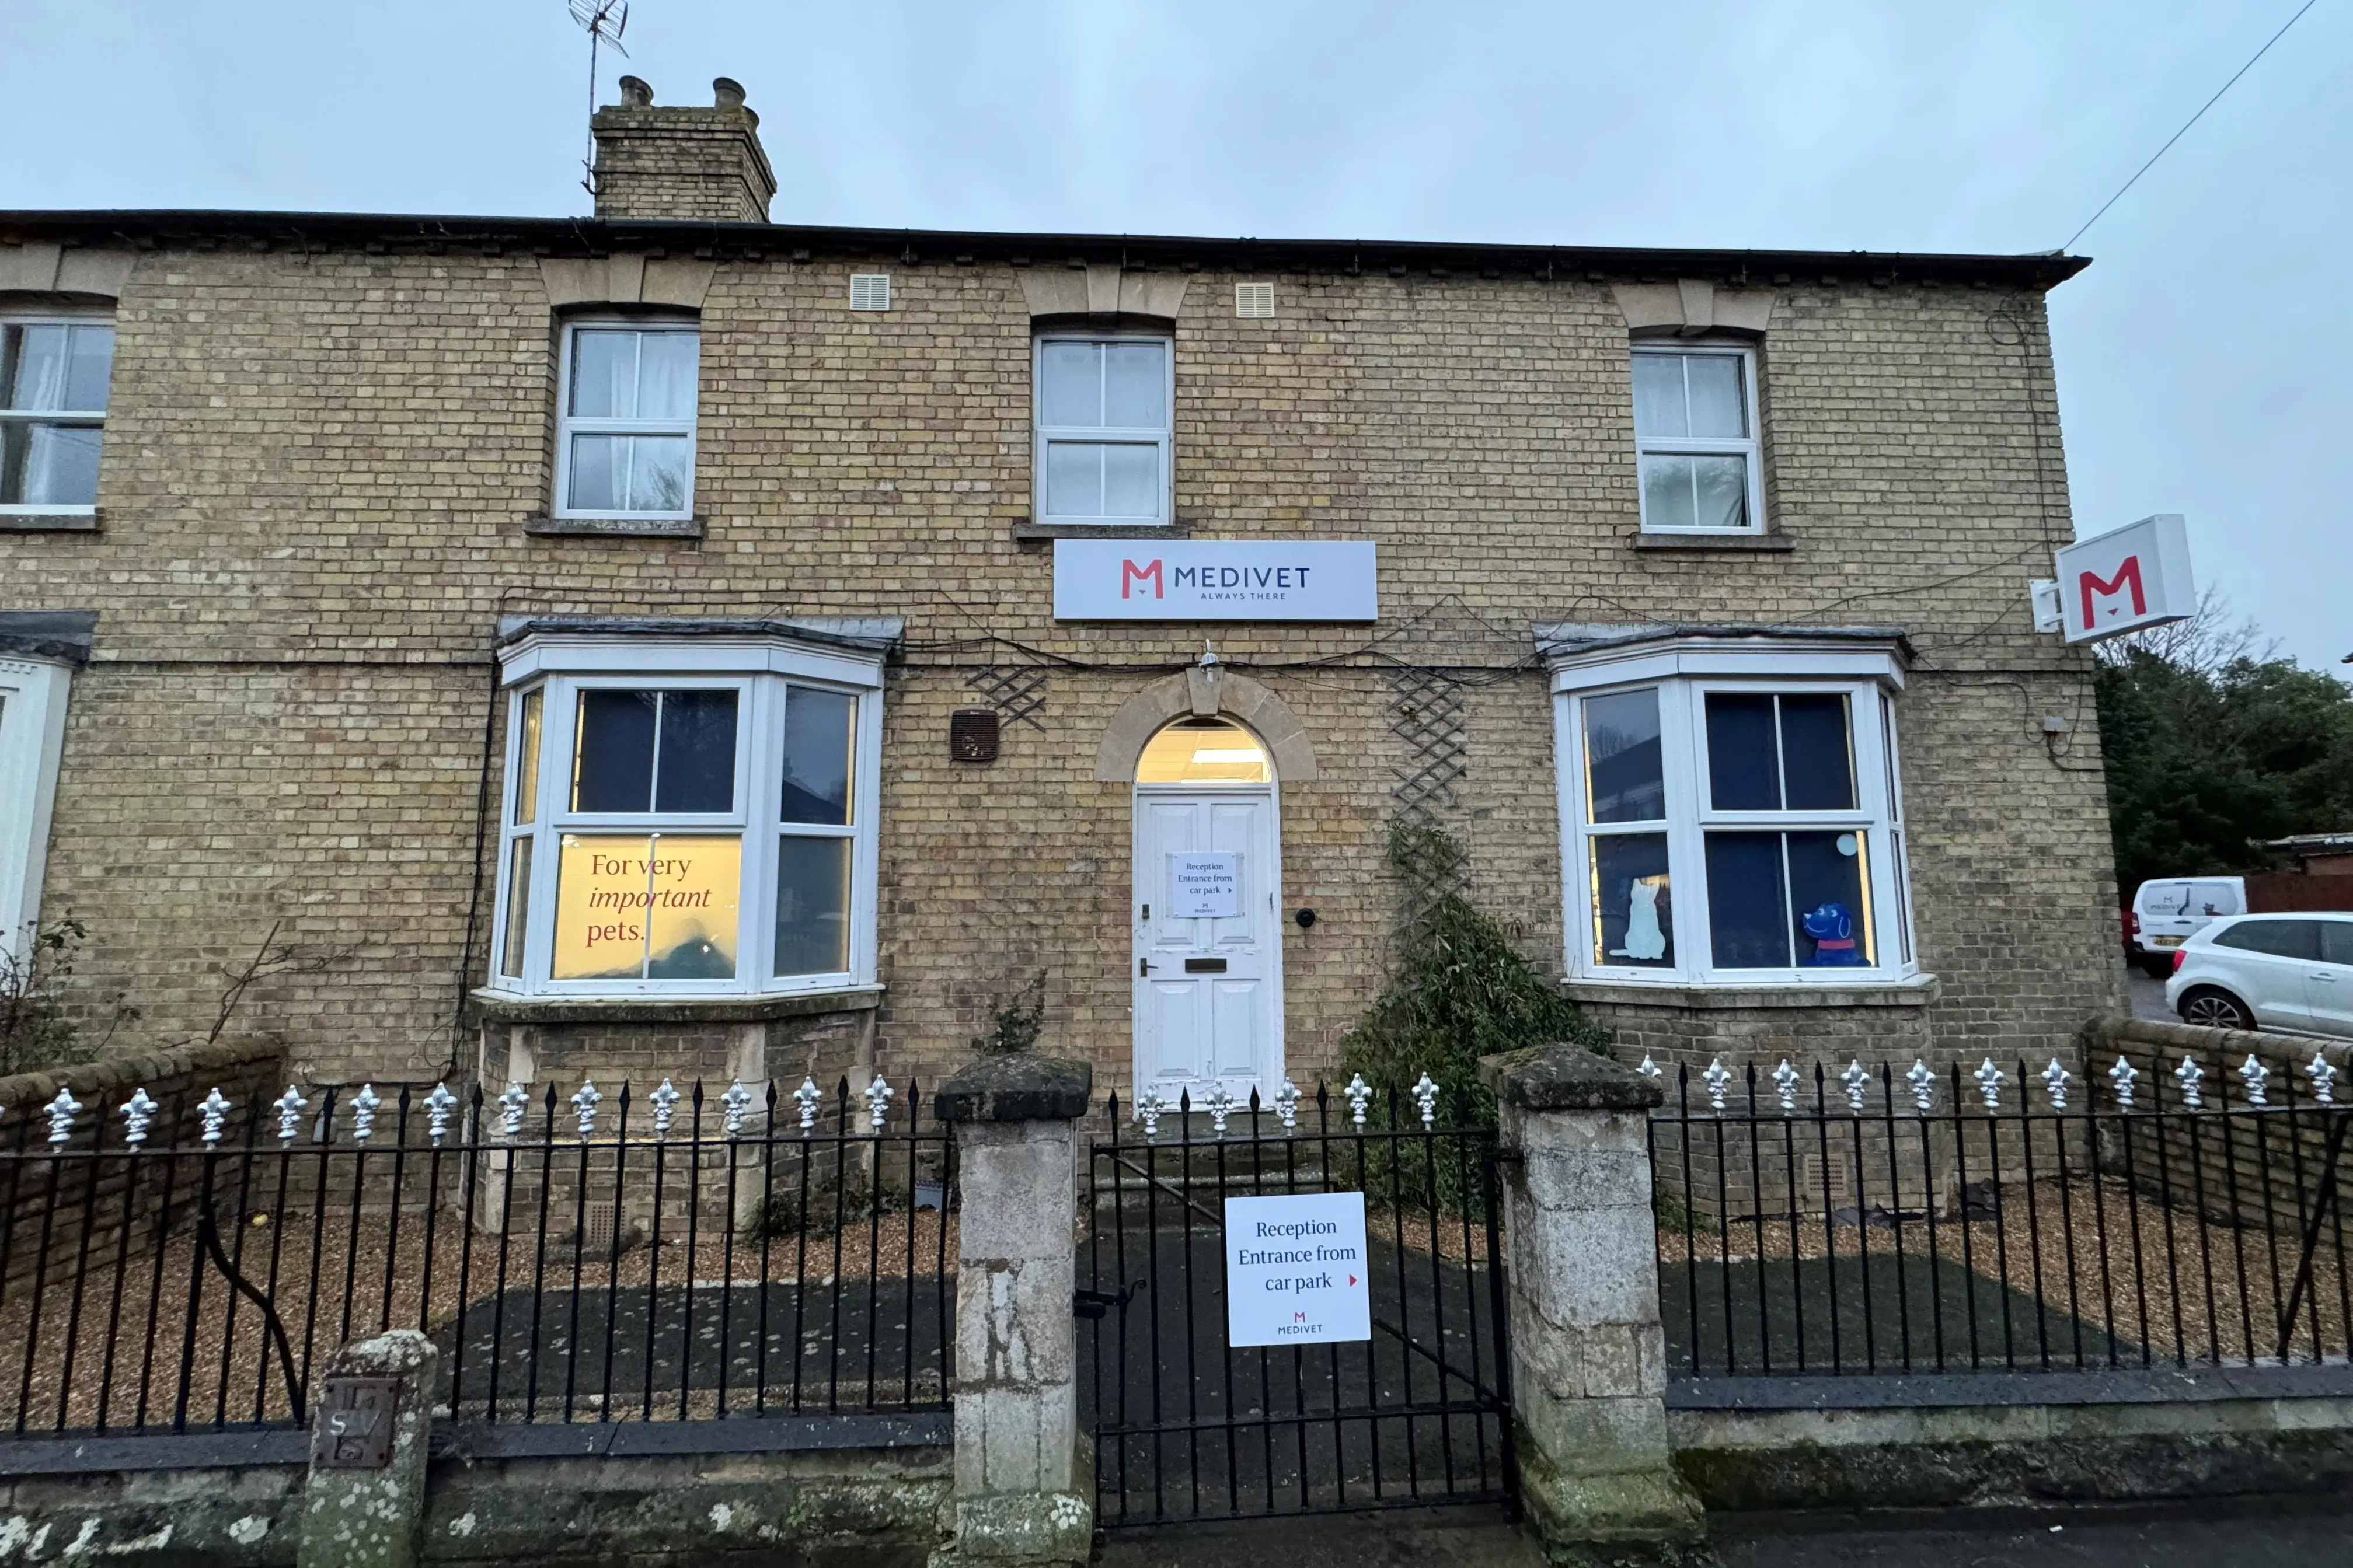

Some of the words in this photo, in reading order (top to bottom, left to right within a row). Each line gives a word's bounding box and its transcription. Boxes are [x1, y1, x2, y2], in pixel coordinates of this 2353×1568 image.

[1121, 559, 1164, 599] M
[1174, 567, 1310, 588] MEDIVET
[2079, 555, 2147, 630] M
[591, 854, 632, 875] For
[637, 860, 692, 882] very
[1186, 862, 1223, 872] Reception
[588, 886, 713, 914] important
[1204, 886, 1221, 896] park
[585, 921, 646, 948] pets.
[1256, 1220, 1337, 1240] Reception
[1238, 1249, 1312, 1265] Entrance
[1317, 1245, 1357, 1262] from
[1265, 1277, 1291, 1291] car
[1295, 1272, 1333, 1294] park
[1294, 1312, 1306, 1323] M
[1278, 1325, 1323, 1335] MEDIVET
